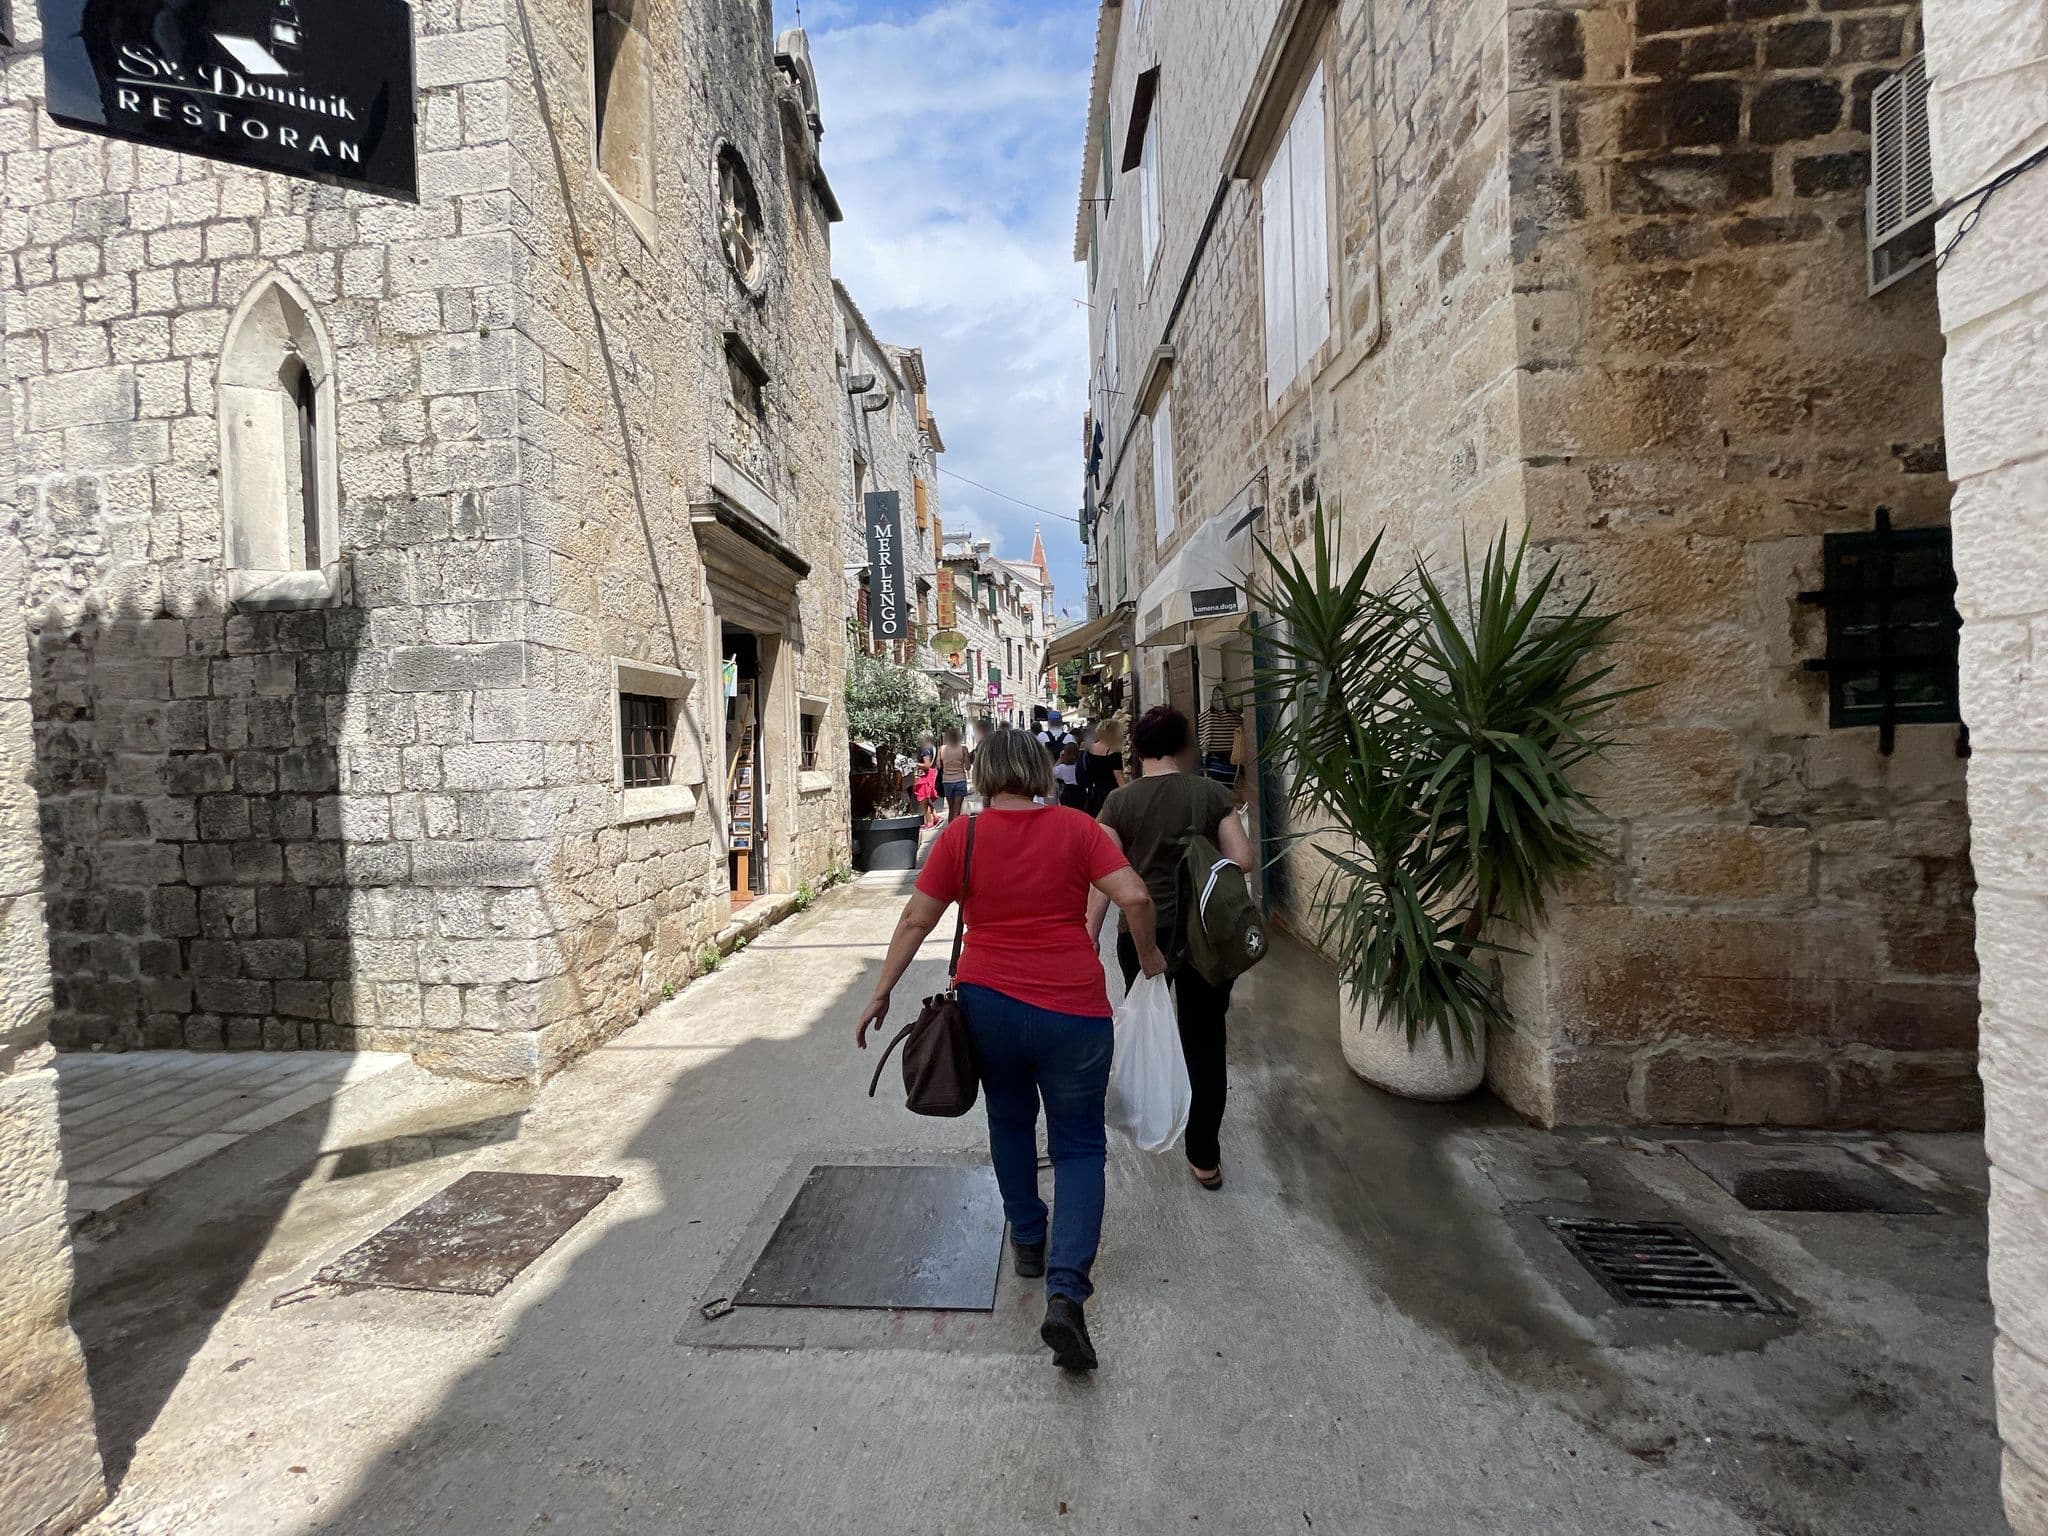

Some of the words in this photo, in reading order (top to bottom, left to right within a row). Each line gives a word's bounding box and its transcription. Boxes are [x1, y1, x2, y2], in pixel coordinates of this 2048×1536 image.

[118, 44, 186, 82] Sv.
[197, 64, 356, 122] Dominik
[117, 87, 361, 164] RESTORAN
